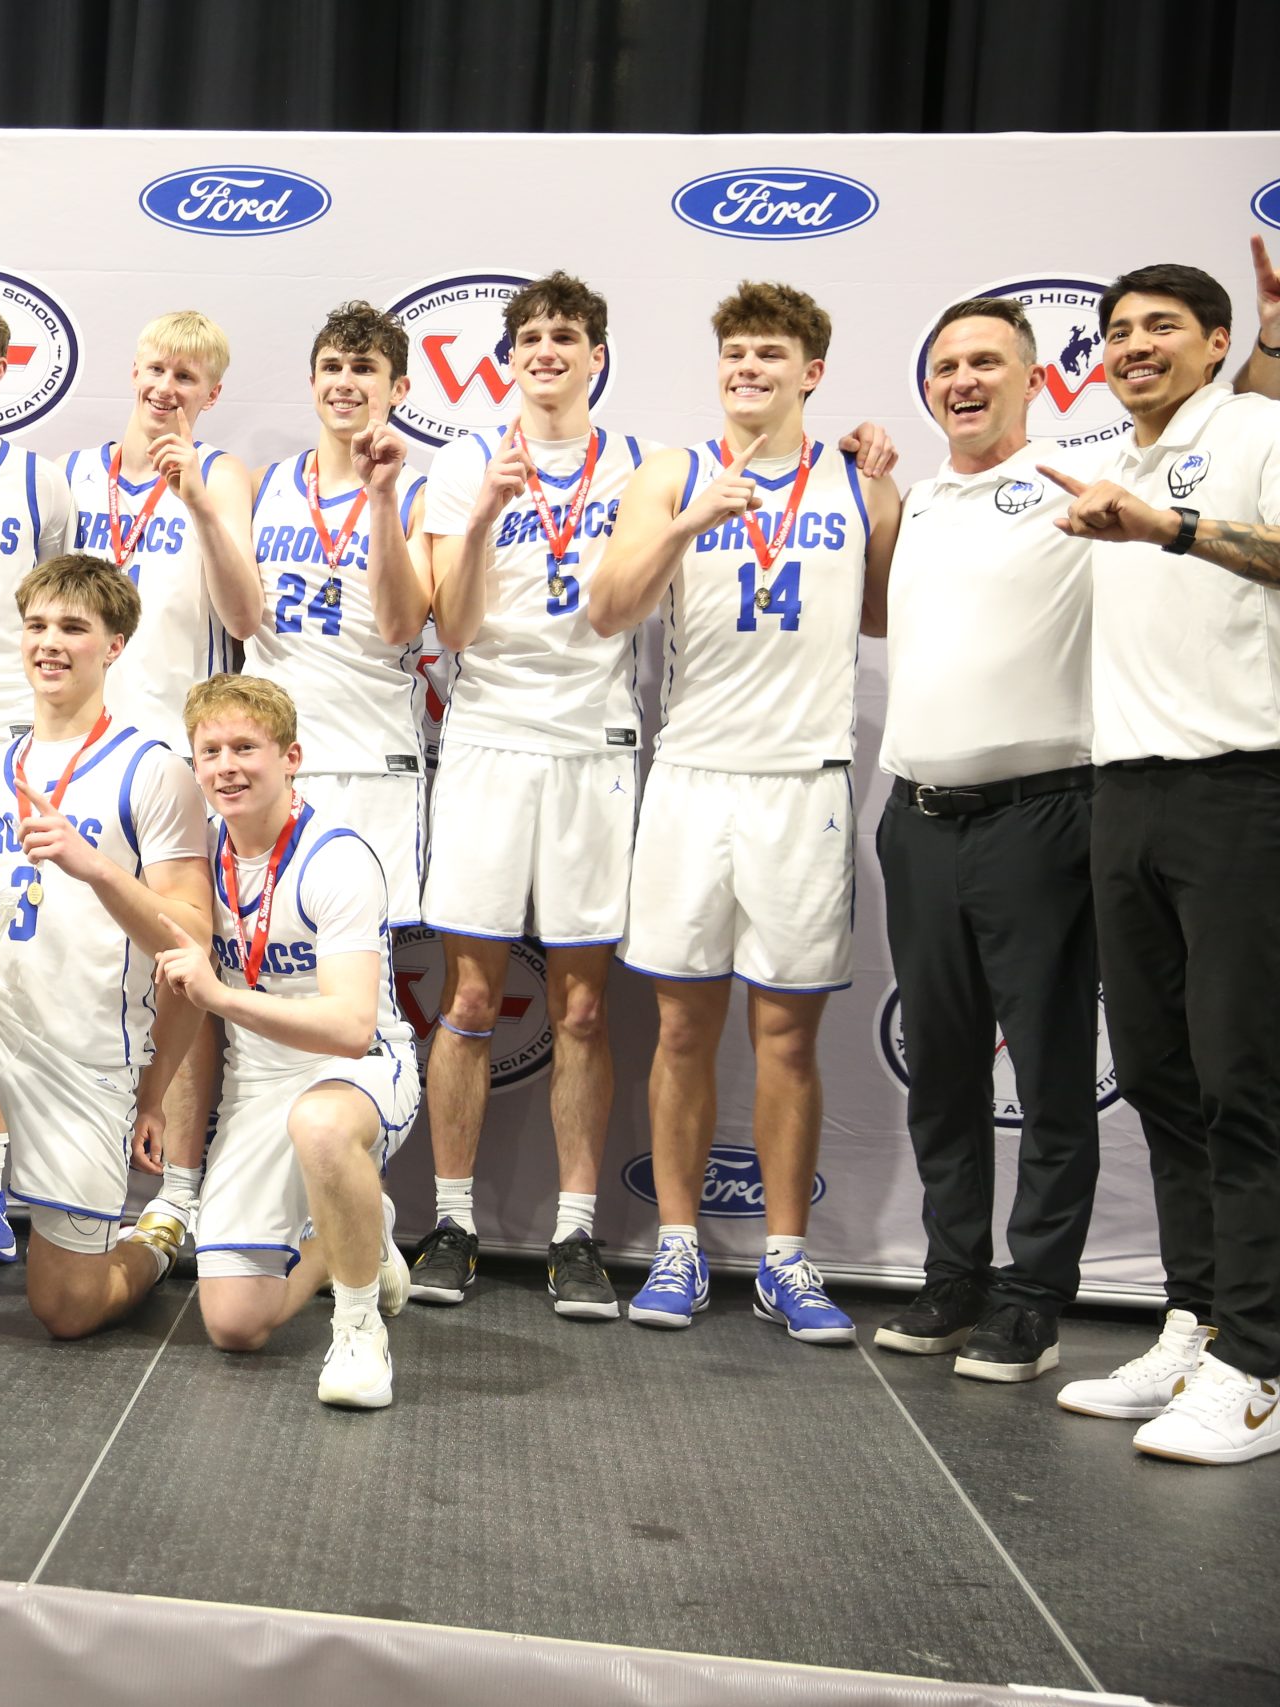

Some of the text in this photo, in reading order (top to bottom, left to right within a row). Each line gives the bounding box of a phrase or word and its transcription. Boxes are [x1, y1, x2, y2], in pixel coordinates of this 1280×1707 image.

[177, 176, 294, 223] Ford
[712, 178, 838, 226] Ford
[2, 287, 60, 341] SCHOOL
[1039, 293, 1096, 308] HIGH
[276, 572, 343, 636] 24
[546, 552, 580, 617] 5
[736, 561, 802, 632] 14
[7, 865, 42, 942] 3
